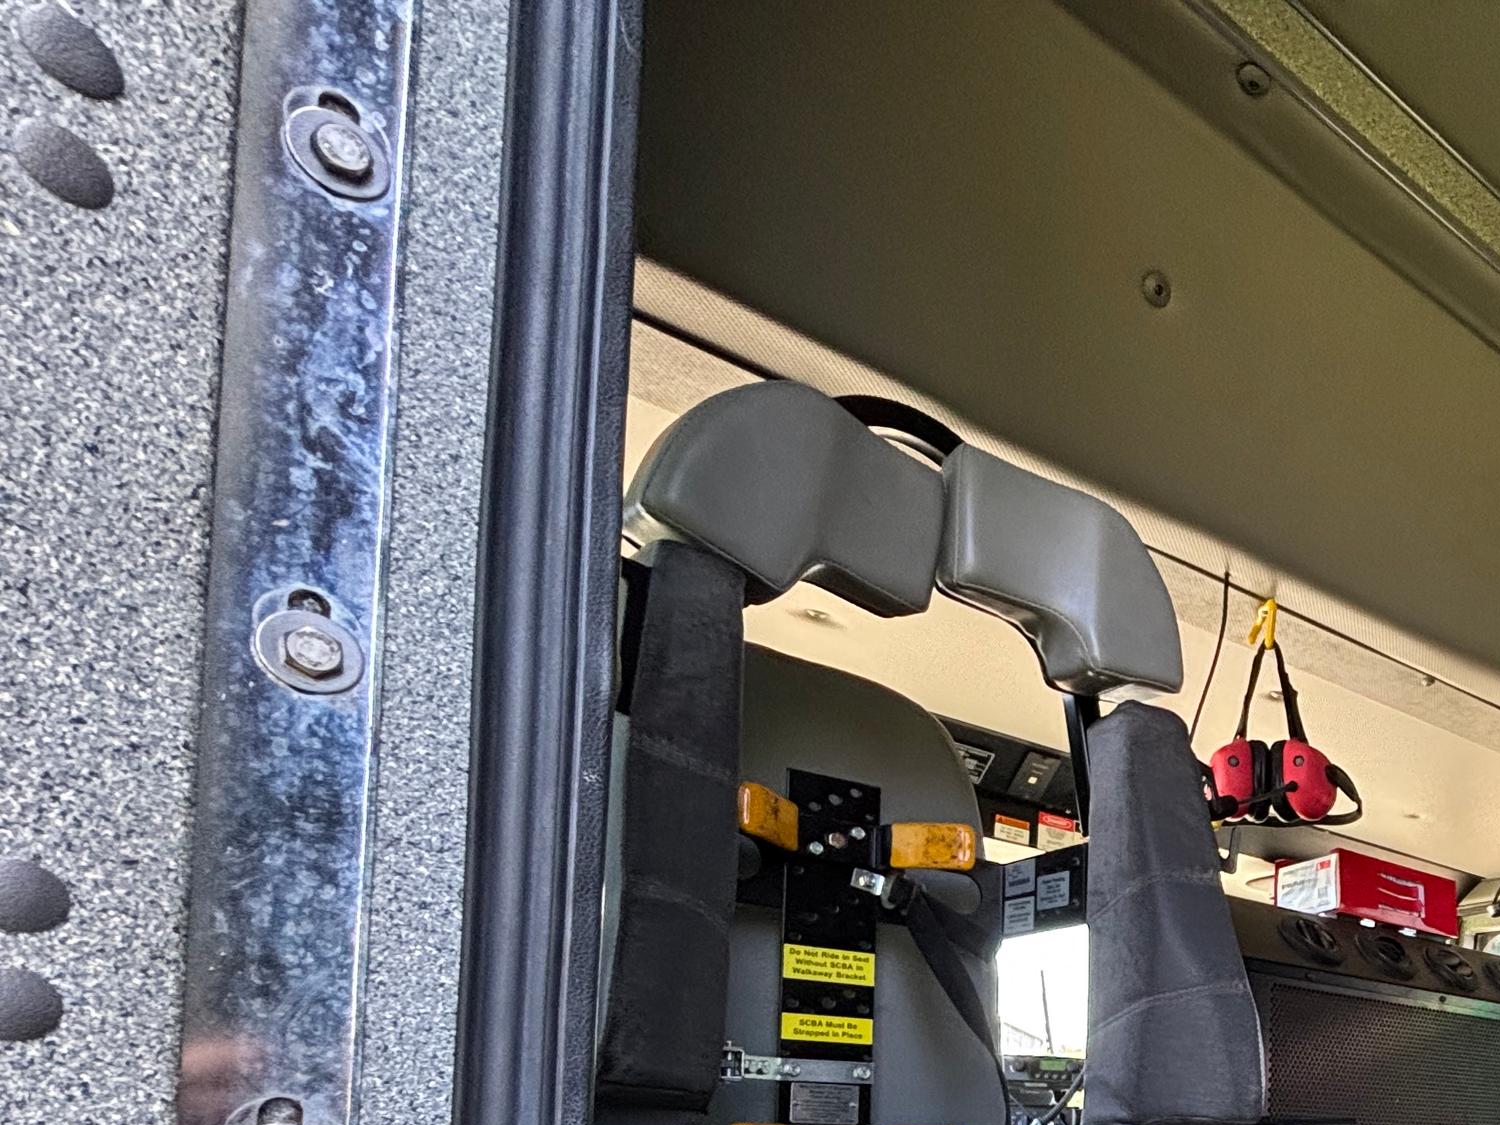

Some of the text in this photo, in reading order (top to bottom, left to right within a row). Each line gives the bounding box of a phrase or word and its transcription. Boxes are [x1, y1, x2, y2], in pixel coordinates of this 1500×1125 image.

[804, 950, 818, 958] Not
[796, 958, 828, 968] Without
[830, 962, 853, 970] SCBA
[792, 967, 866, 980] Walkaway Bracket
[799, 1019, 823, 1027] SCBA
[826, 1021, 845, 1029] Must
[793, 1028, 830, 1037] Strapped
[842, 1032, 863, 1040] Place
